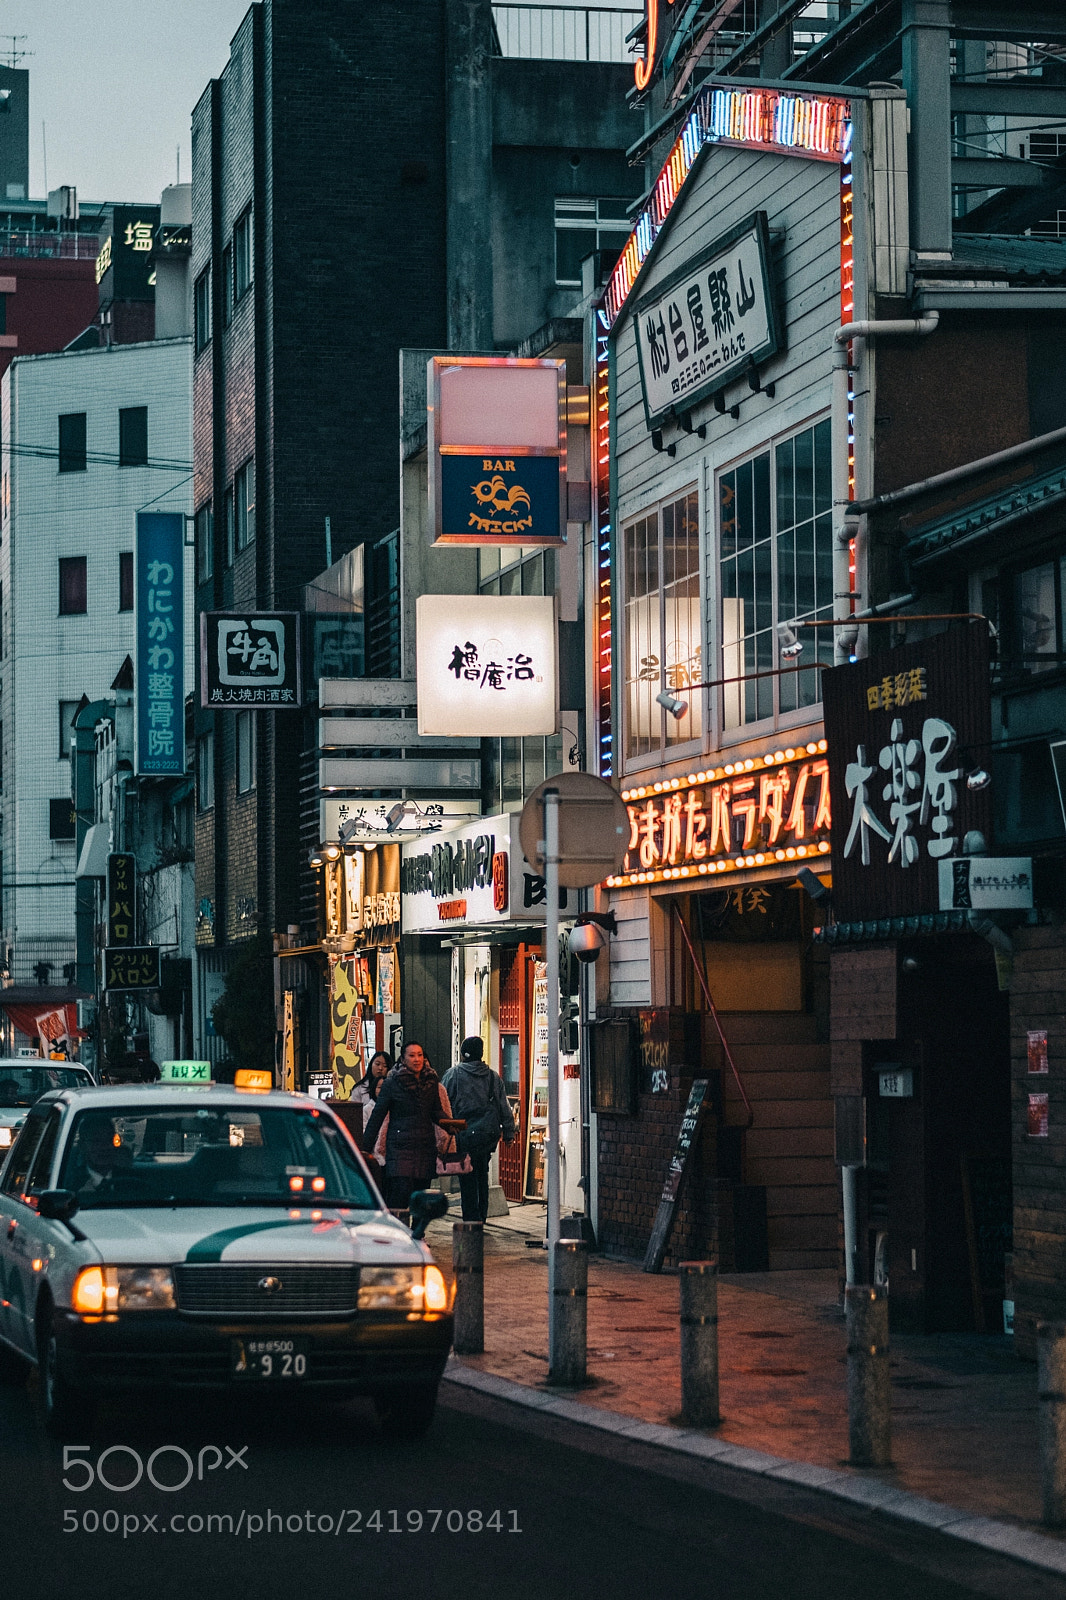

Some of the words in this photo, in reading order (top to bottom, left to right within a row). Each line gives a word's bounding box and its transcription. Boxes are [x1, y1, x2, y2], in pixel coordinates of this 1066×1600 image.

[482, 459, 516, 472] BAR
[467, 512, 533, 534] TRICKY
[147, 559, 175, 757] わにかわ整骨院
[227, 631, 279, 671] 牛角
[171, 1065, 207, 1079] 観光
